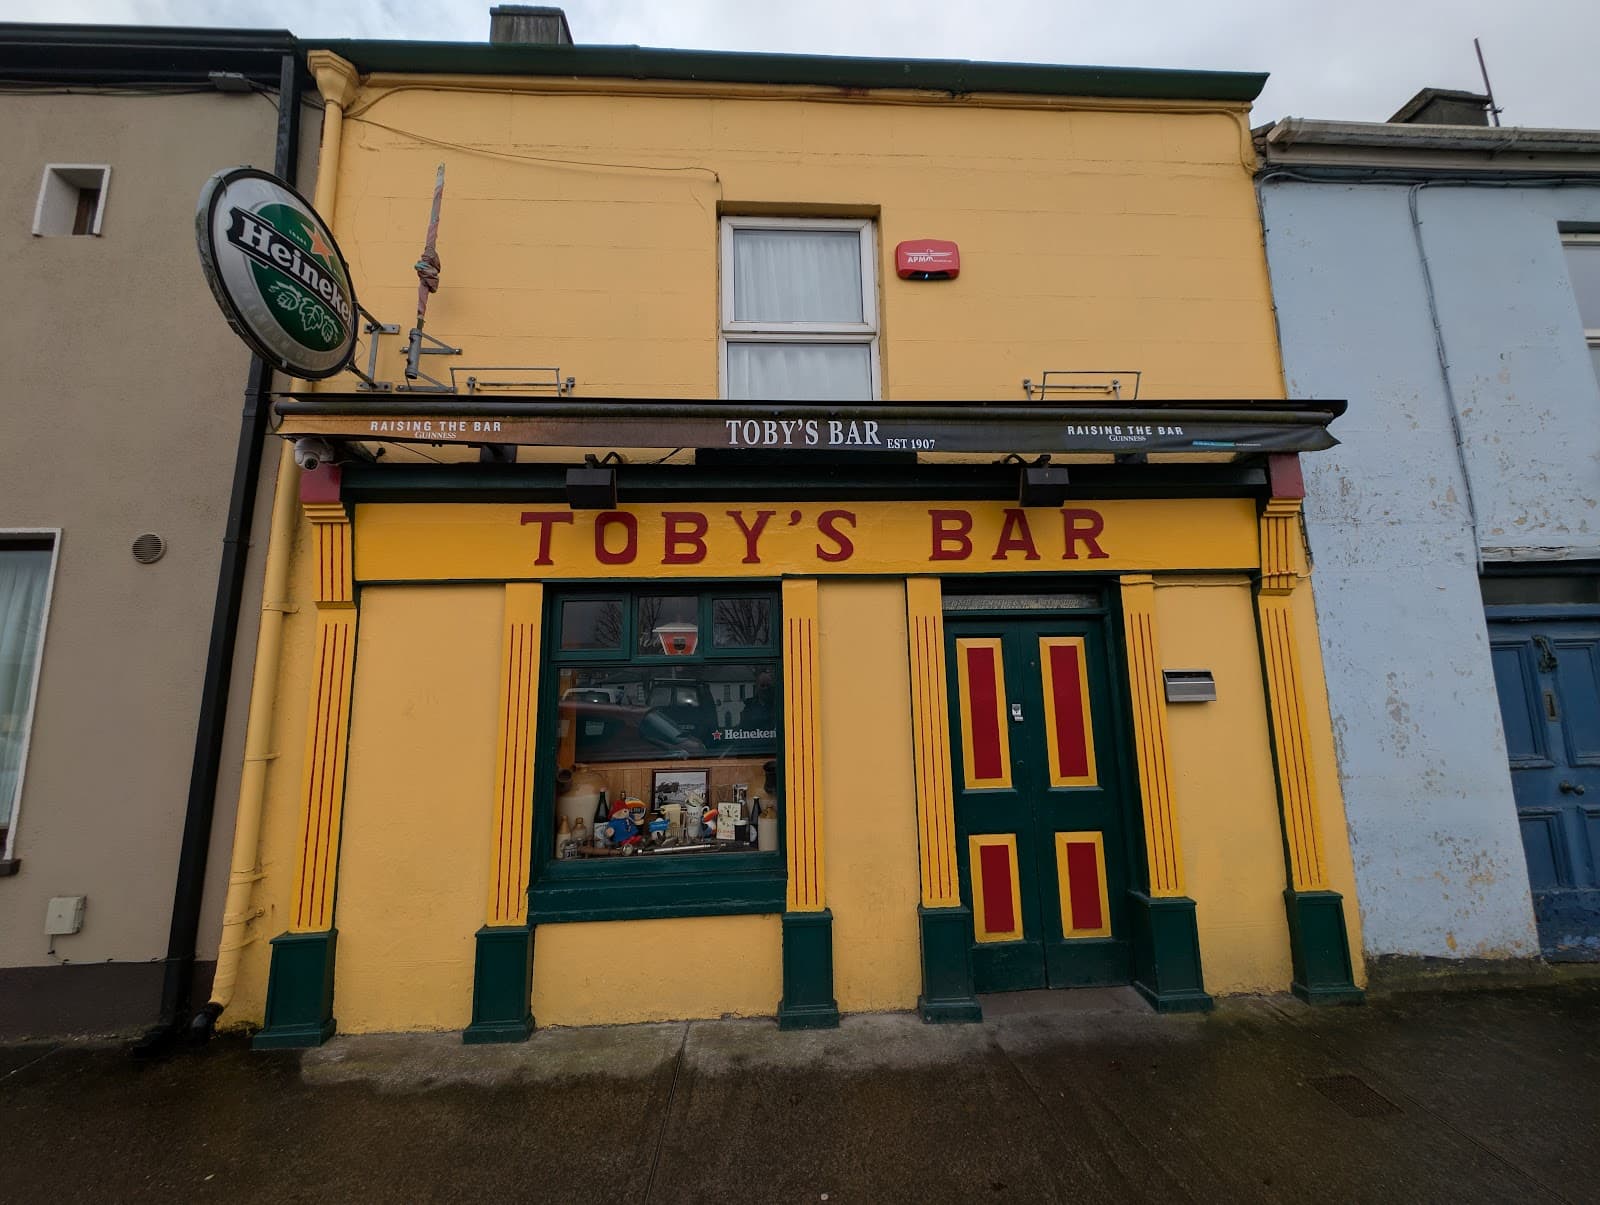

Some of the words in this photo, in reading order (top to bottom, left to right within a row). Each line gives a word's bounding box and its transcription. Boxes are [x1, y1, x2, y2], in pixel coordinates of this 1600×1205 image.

[370, 421, 432, 432] RAISING
[439, 421, 466, 432] THE
[474, 421, 502, 432] BAR
[1067, 425, 1122, 436] RAISING
[1128, 425, 1152, 436] THE
[1158, 426, 1184, 436] BAR
[415, 430, 457, 440] GUINNESS
[726, 419, 819, 446] TOBY'S
[828, 420, 881, 445] BAR
[1109, 434, 1147, 442] GUINNESS
[886, 438, 908, 449] EST
[910, 439, 936, 449] 1907
[520, 508, 857, 566] TOBY'S
[928, 508, 1109, 561] BAR
[724, 728, 777, 740] Heineken
